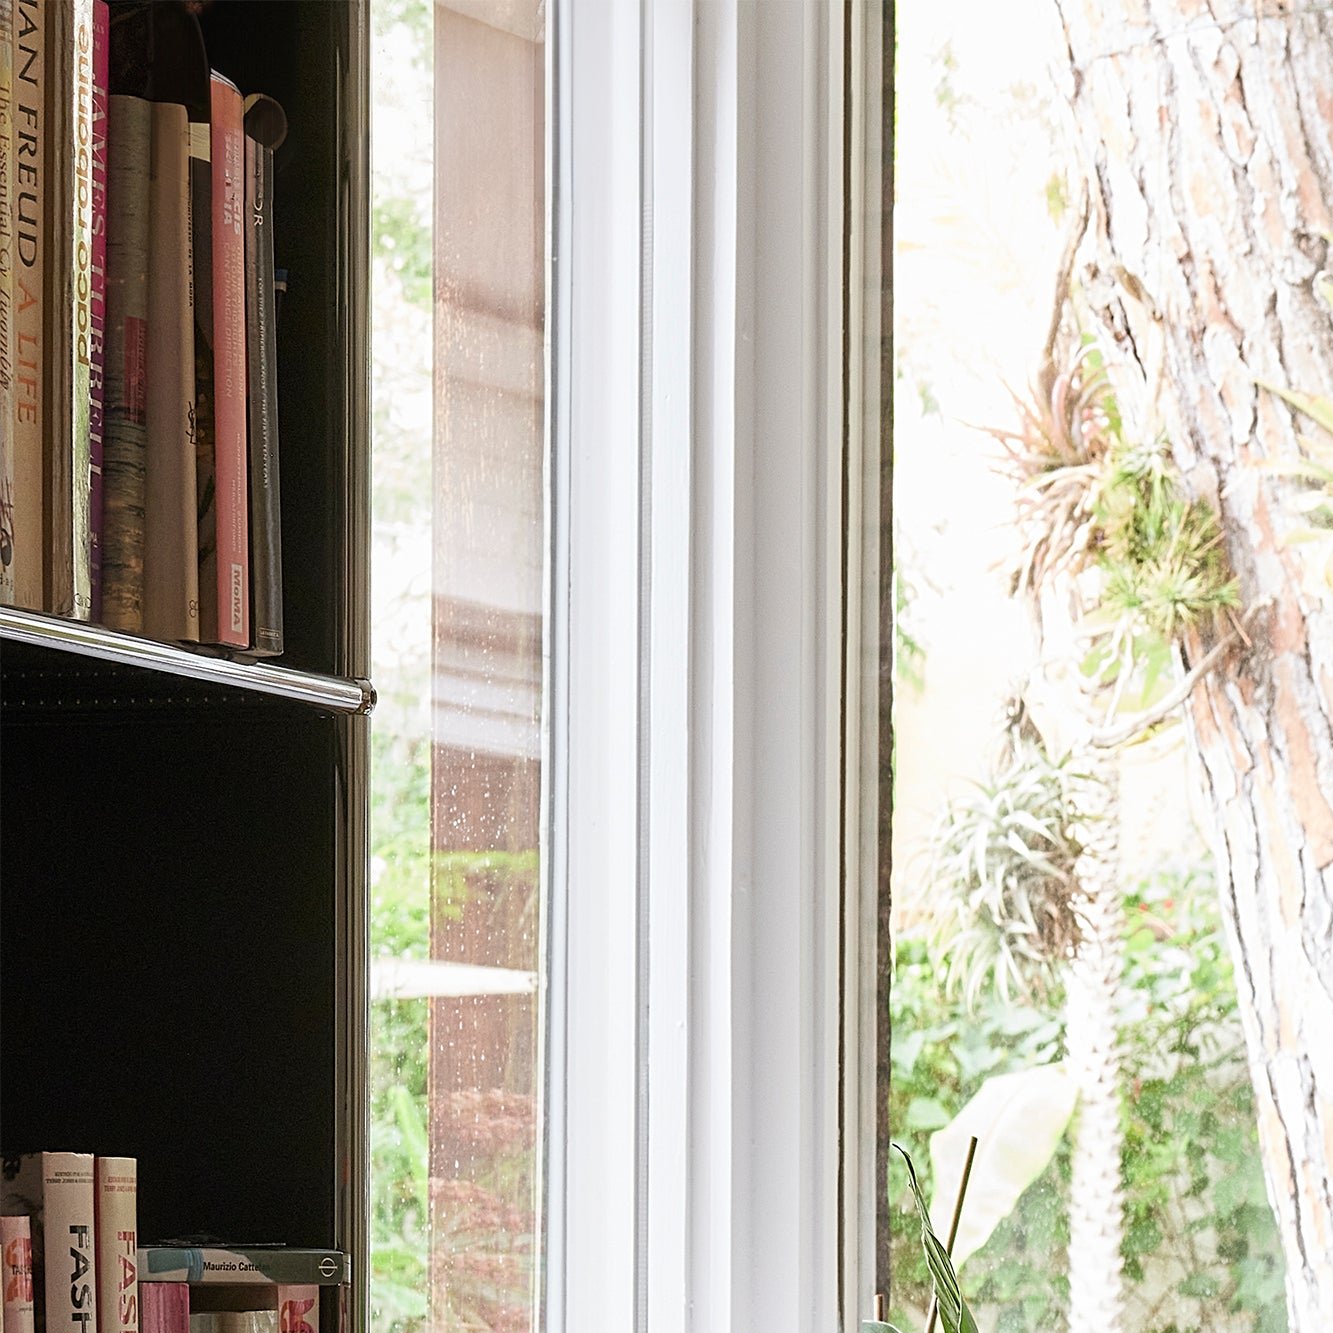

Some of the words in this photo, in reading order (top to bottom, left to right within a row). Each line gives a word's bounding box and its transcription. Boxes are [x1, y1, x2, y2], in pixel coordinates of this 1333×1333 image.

[76, 24, 93, 230] rabanne
[91, 72, 107, 238] JAMES
[18, 103, 38, 268] FREUD
[17, 277, 37, 313] A
[77, 240, 91, 366] paco
[17, 330, 38, 425] LIFE
[90, 254, 106, 491] TURRELL
[225, 327, 233, 398] DIRECTION
[232, 569, 242, 627] MoMA
[203, 1261, 237, 1272] Maurizio
